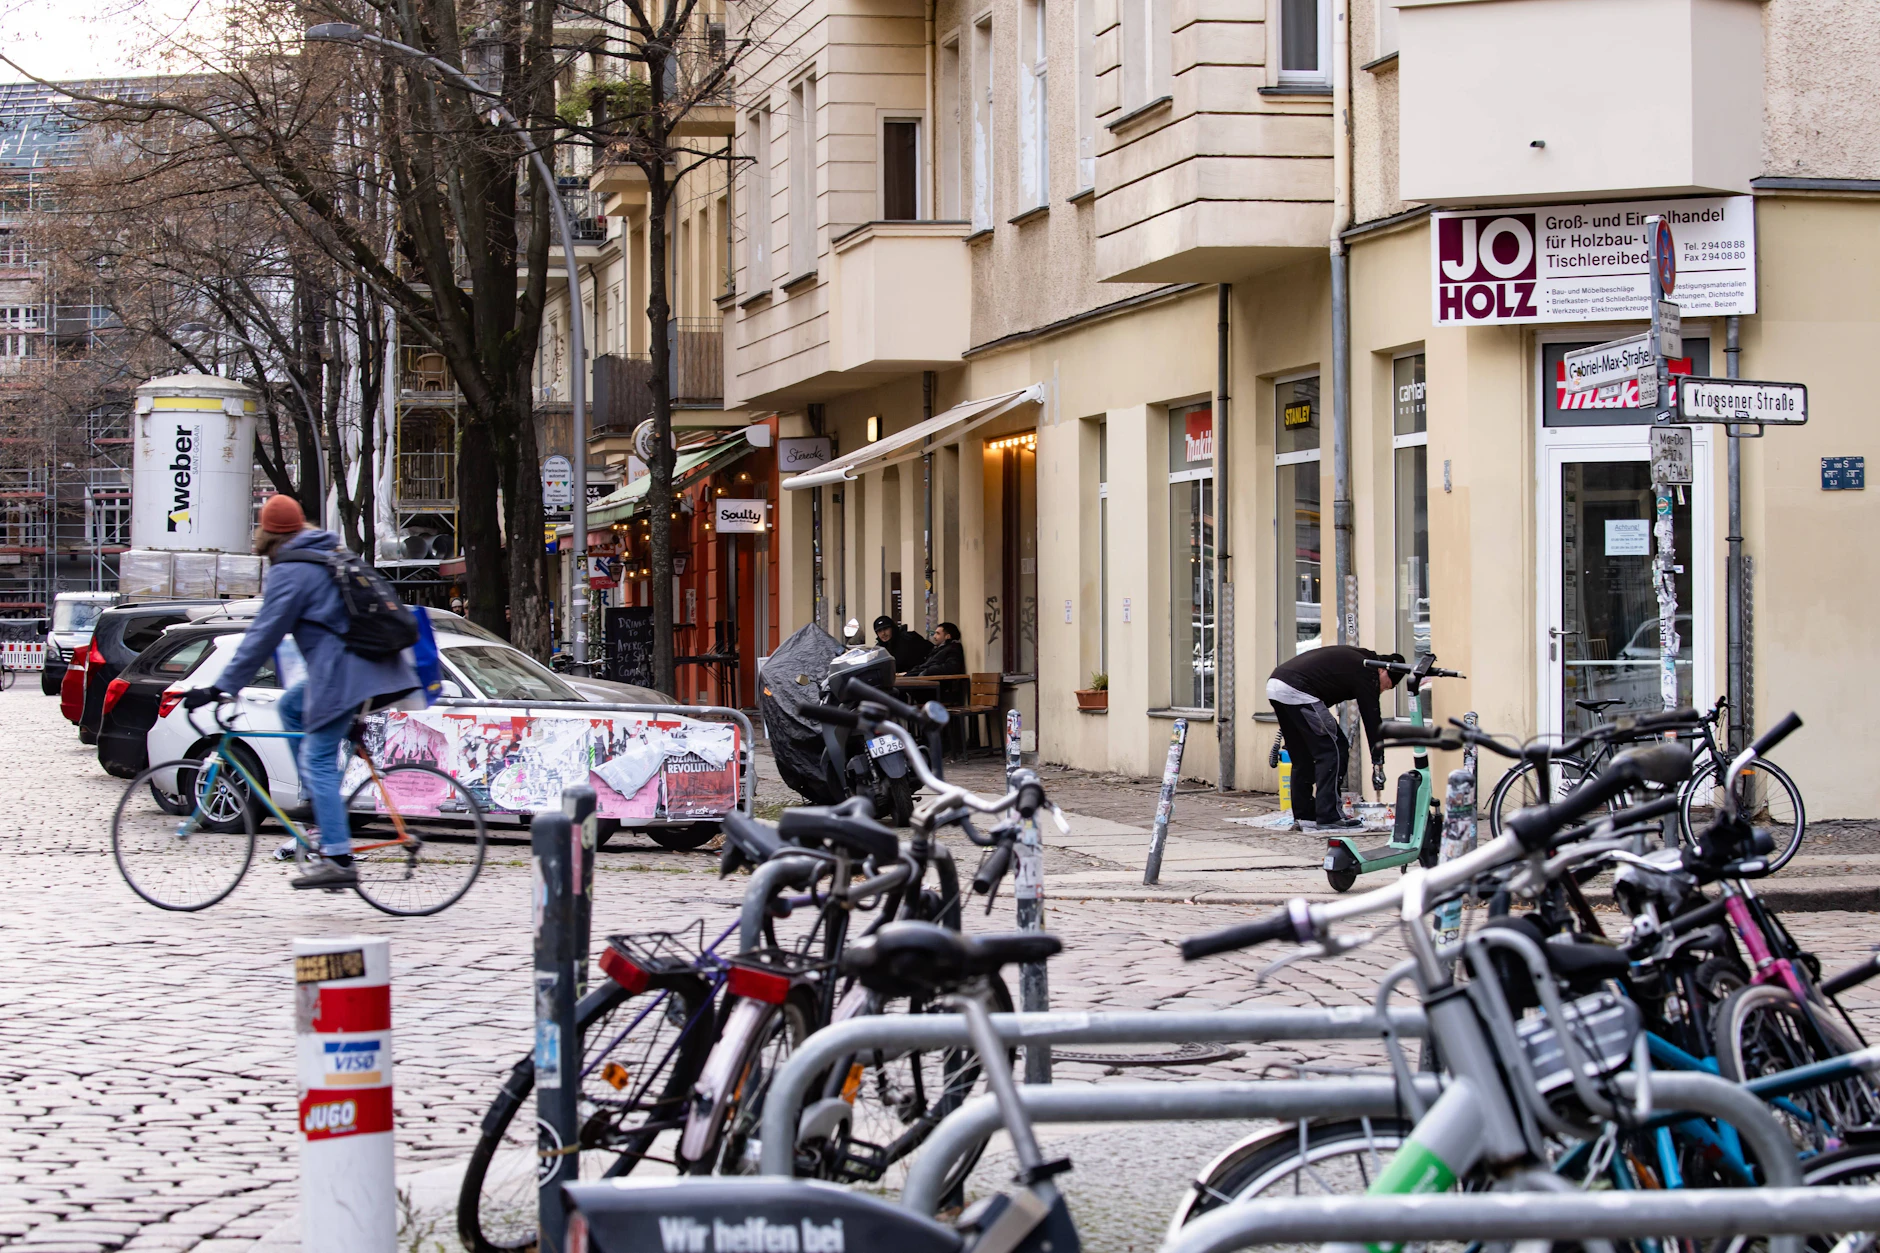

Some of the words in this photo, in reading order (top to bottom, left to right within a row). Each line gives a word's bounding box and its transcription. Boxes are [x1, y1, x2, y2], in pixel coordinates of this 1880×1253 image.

[1546, 215, 1588, 230] Groß-
[1592, 213, 1620, 228] und
[1625, 207, 1725, 227] Einelhandel
[1441, 217, 1534, 281] JO
[1546, 235, 1566, 249] für
[1571, 233, 1639, 248] Holzbau-
[1684, 242, 1700, 251] Tel.
[1545, 250, 1649, 268] Tischlereibed
[1684, 253, 1700, 262] Fax
[1673, 282, 1746, 291] efestigungsmaterialien
[1440, 282, 1537, 320] HOLZ
[1400, 378, 1426, 402] carhar
[1694, 388, 1753, 410] Krossener
[1757, 392, 1795, 411] Straße
[1285, 405, 1310, 426] STANLEY
[192, 425, 200, 475] SAINT-GOBAIN
[1185, 429, 1213, 463] makit
[169, 424, 192, 512] weber
[1822, 460, 1828, 468] S
[1842, 460, 1849, 468] S
[720, 509, 762, 524] Soulty
[1615, 524, 1640, 532] Achtung!
[878, 738, 886, 746] B
[304, 1100, 357, 1131] JUGO
[658, 1216, 710, 1253] Wir
[713, 1216, 799, 1253] helfen
[801, 1217, 845, 1253] bei
